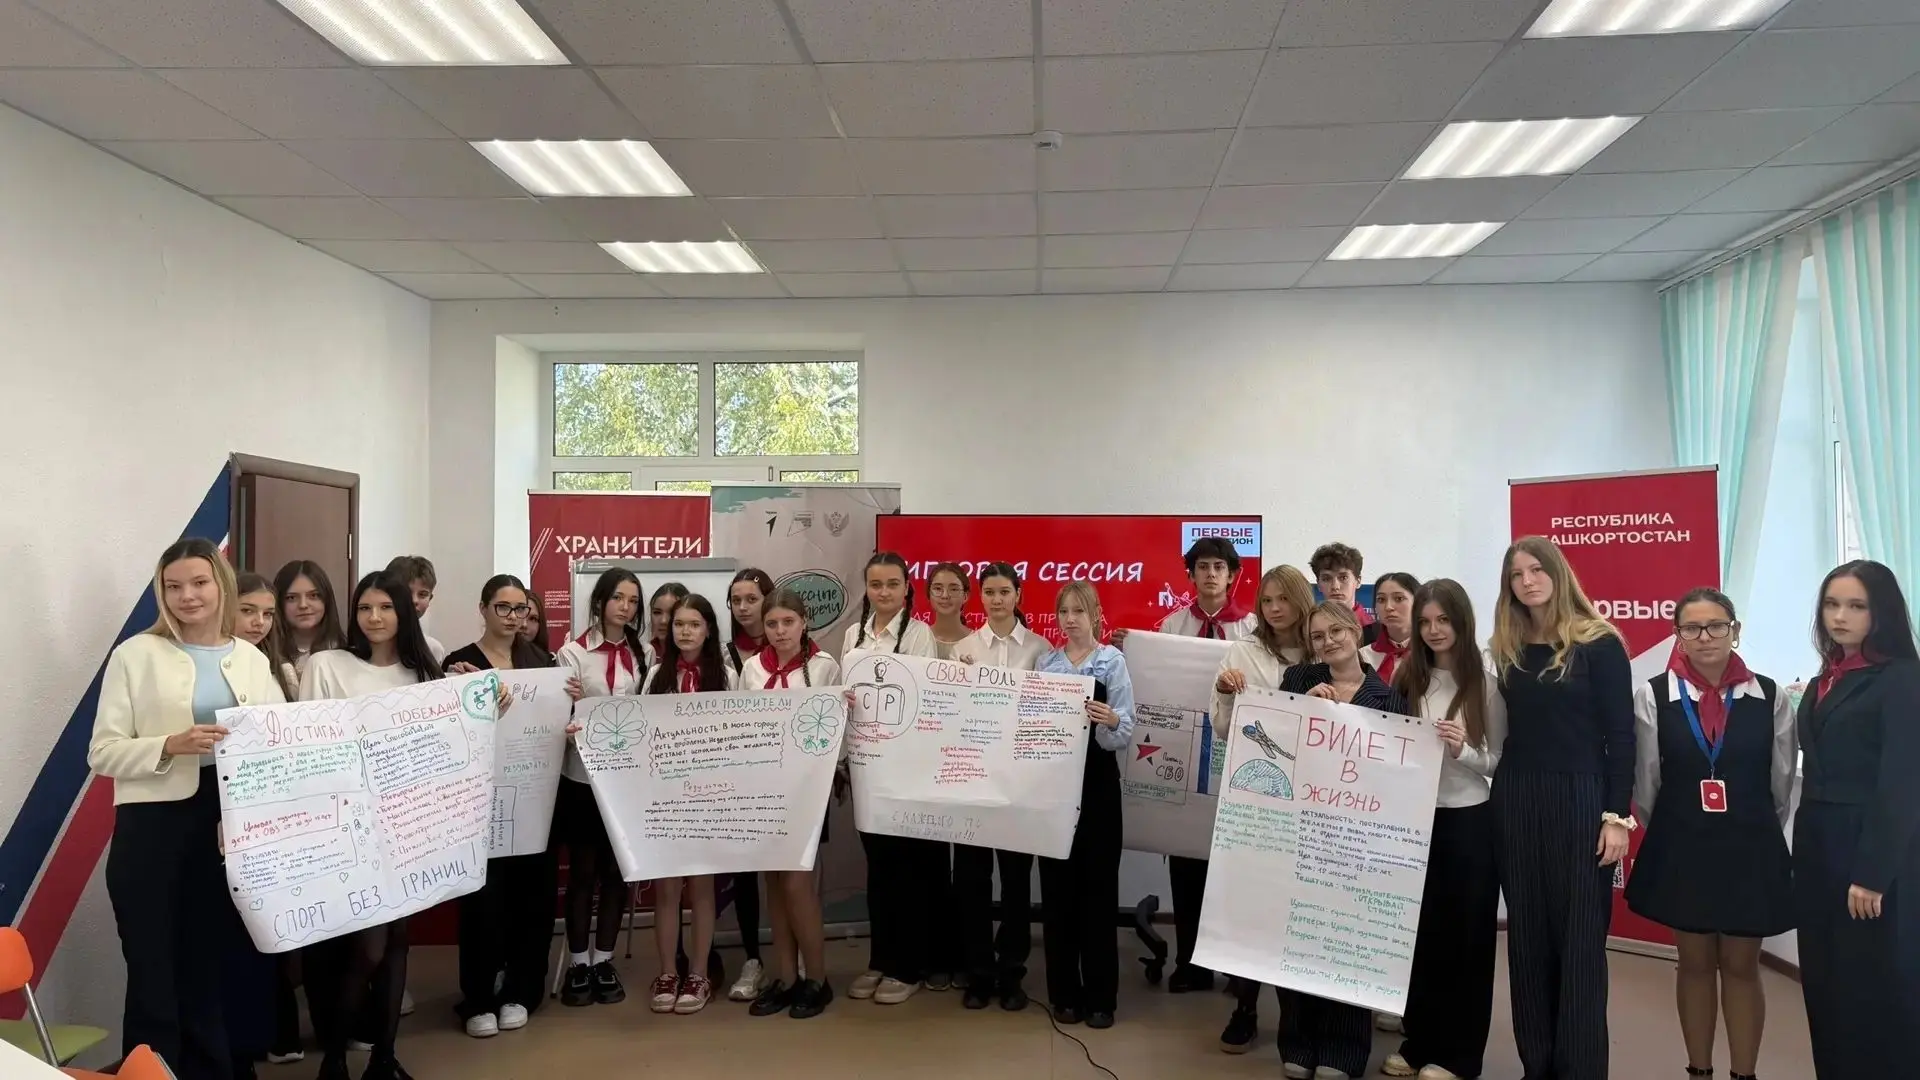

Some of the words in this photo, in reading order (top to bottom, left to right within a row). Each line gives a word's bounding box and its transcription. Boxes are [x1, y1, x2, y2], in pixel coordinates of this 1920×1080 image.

[1551, 512, 1674, 529] РЕСПУБЛИКА
[1191, 527, 1253, 537] ПЕРВЫЕ
[555, 535, 702, 554] ХРАНИТЕЛИ
[1038, 560, 1144, 582] СЕССИЯ
[1593, 599, 1676, 620] рвые
[926, 660, 972, 683] СВОЯ
[978, 666, 1016, 687] РОЛЬ
[862, 692, 871, 711] С
[884, 693, 896, 712] Р
[1306, 717, 1416, 767] БИЛЕТ
[1156, 765, 1185, 782] СВО
[1340, 759, 1360, 783] В
[1300, 783, 1382, 812] ЖИЗНЬ
[1300, 810, 1356, 825] АКТУАЛЬНОСТЬ:
[1359, 819, 1412, 834] ПОСТУПЛЕНИЕ
[273, 901, 327, 939] СПОРТ
[347, 885, 382, 916] БЕЗ
